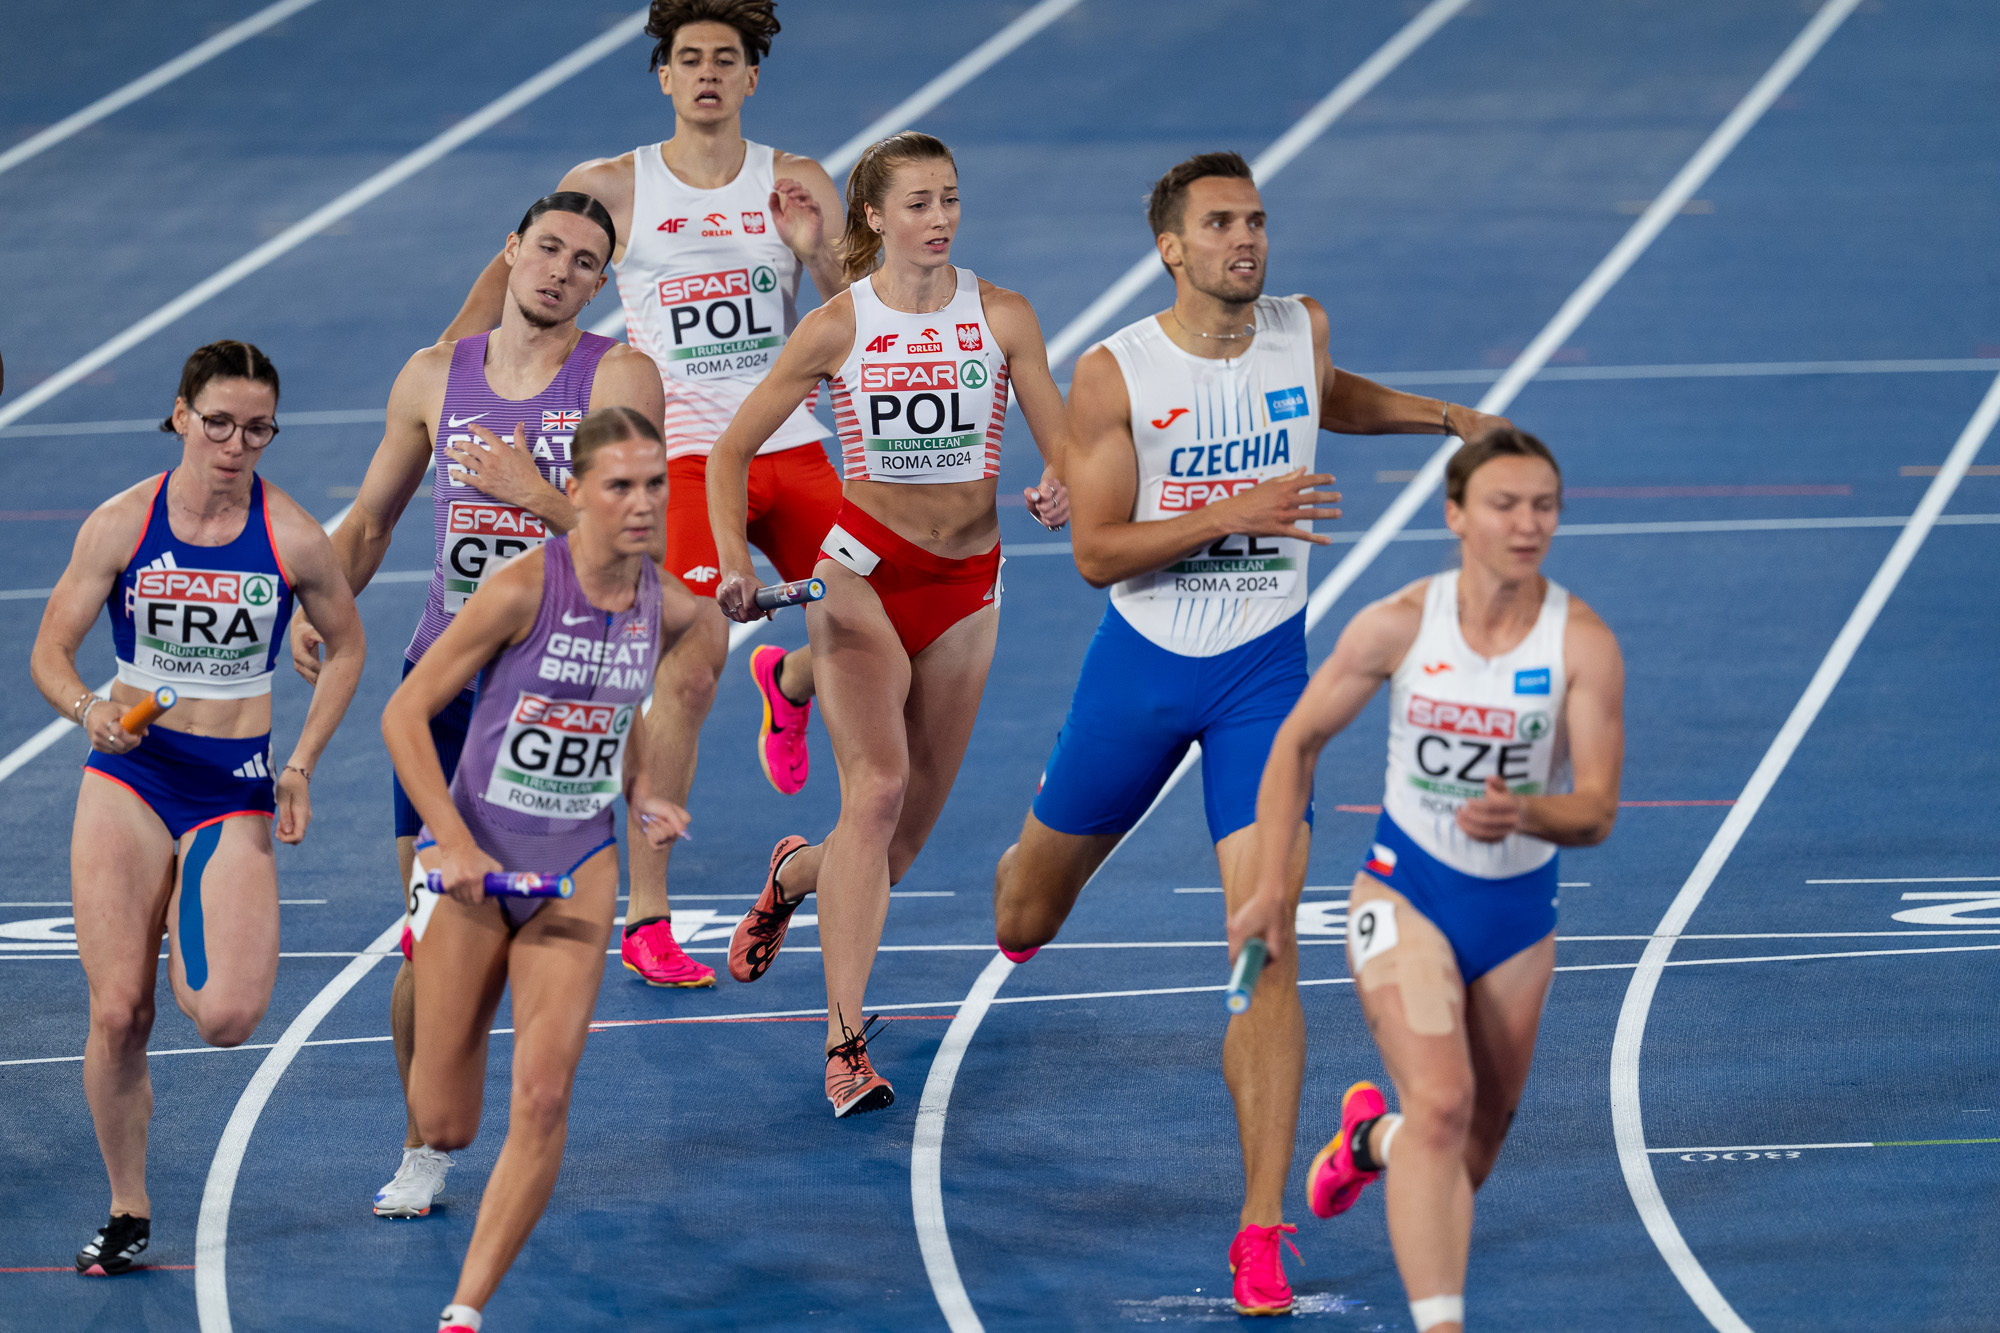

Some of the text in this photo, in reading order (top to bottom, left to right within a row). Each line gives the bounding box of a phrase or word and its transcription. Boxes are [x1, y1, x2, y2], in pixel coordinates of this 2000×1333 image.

[701, 229, 733, 238] ORLEN
[661, 271, 749, 304] SPAR
[670, 298, 772, 345] POL
[697, 345, 722, 356] RUN
[908, 343, 941, 353] ORLEN
[686, 352, 768, 376] ROMA 2024
[863, 365, 956, 389] SPAR
[869, 392, 976, 436] POL
[894, 439, 921, 450] RUN
[1169, 428, 1290, 478] CZECHIA
[881, 451, 972, 470] ROMA 2024
[453, 508, 545, 534] SPAR
[1191, 559, 1220, 572] RUN
[141, 573, 239, 601] SPAR
[1175, 576, 1279, 593] ROMA 2024
[147, 602, 259, 646] FRA
[168, 644, 195, 657] RUN
[546, 632, 650, 666] GREAT
[152, 654, 250, 677] ROMA 2024
[538, 656, 648, 691] BRITAIN
[517, 699, 612, 732] SPAR
[1410, 698, 1514, 739] SPAR
[510, 727, 620, 778] GBR
[1416, 734, 1533, 783] CZE
[508, 787, 602, 814] ROMA 2024
[1358, 911, 1377, 951] 9
